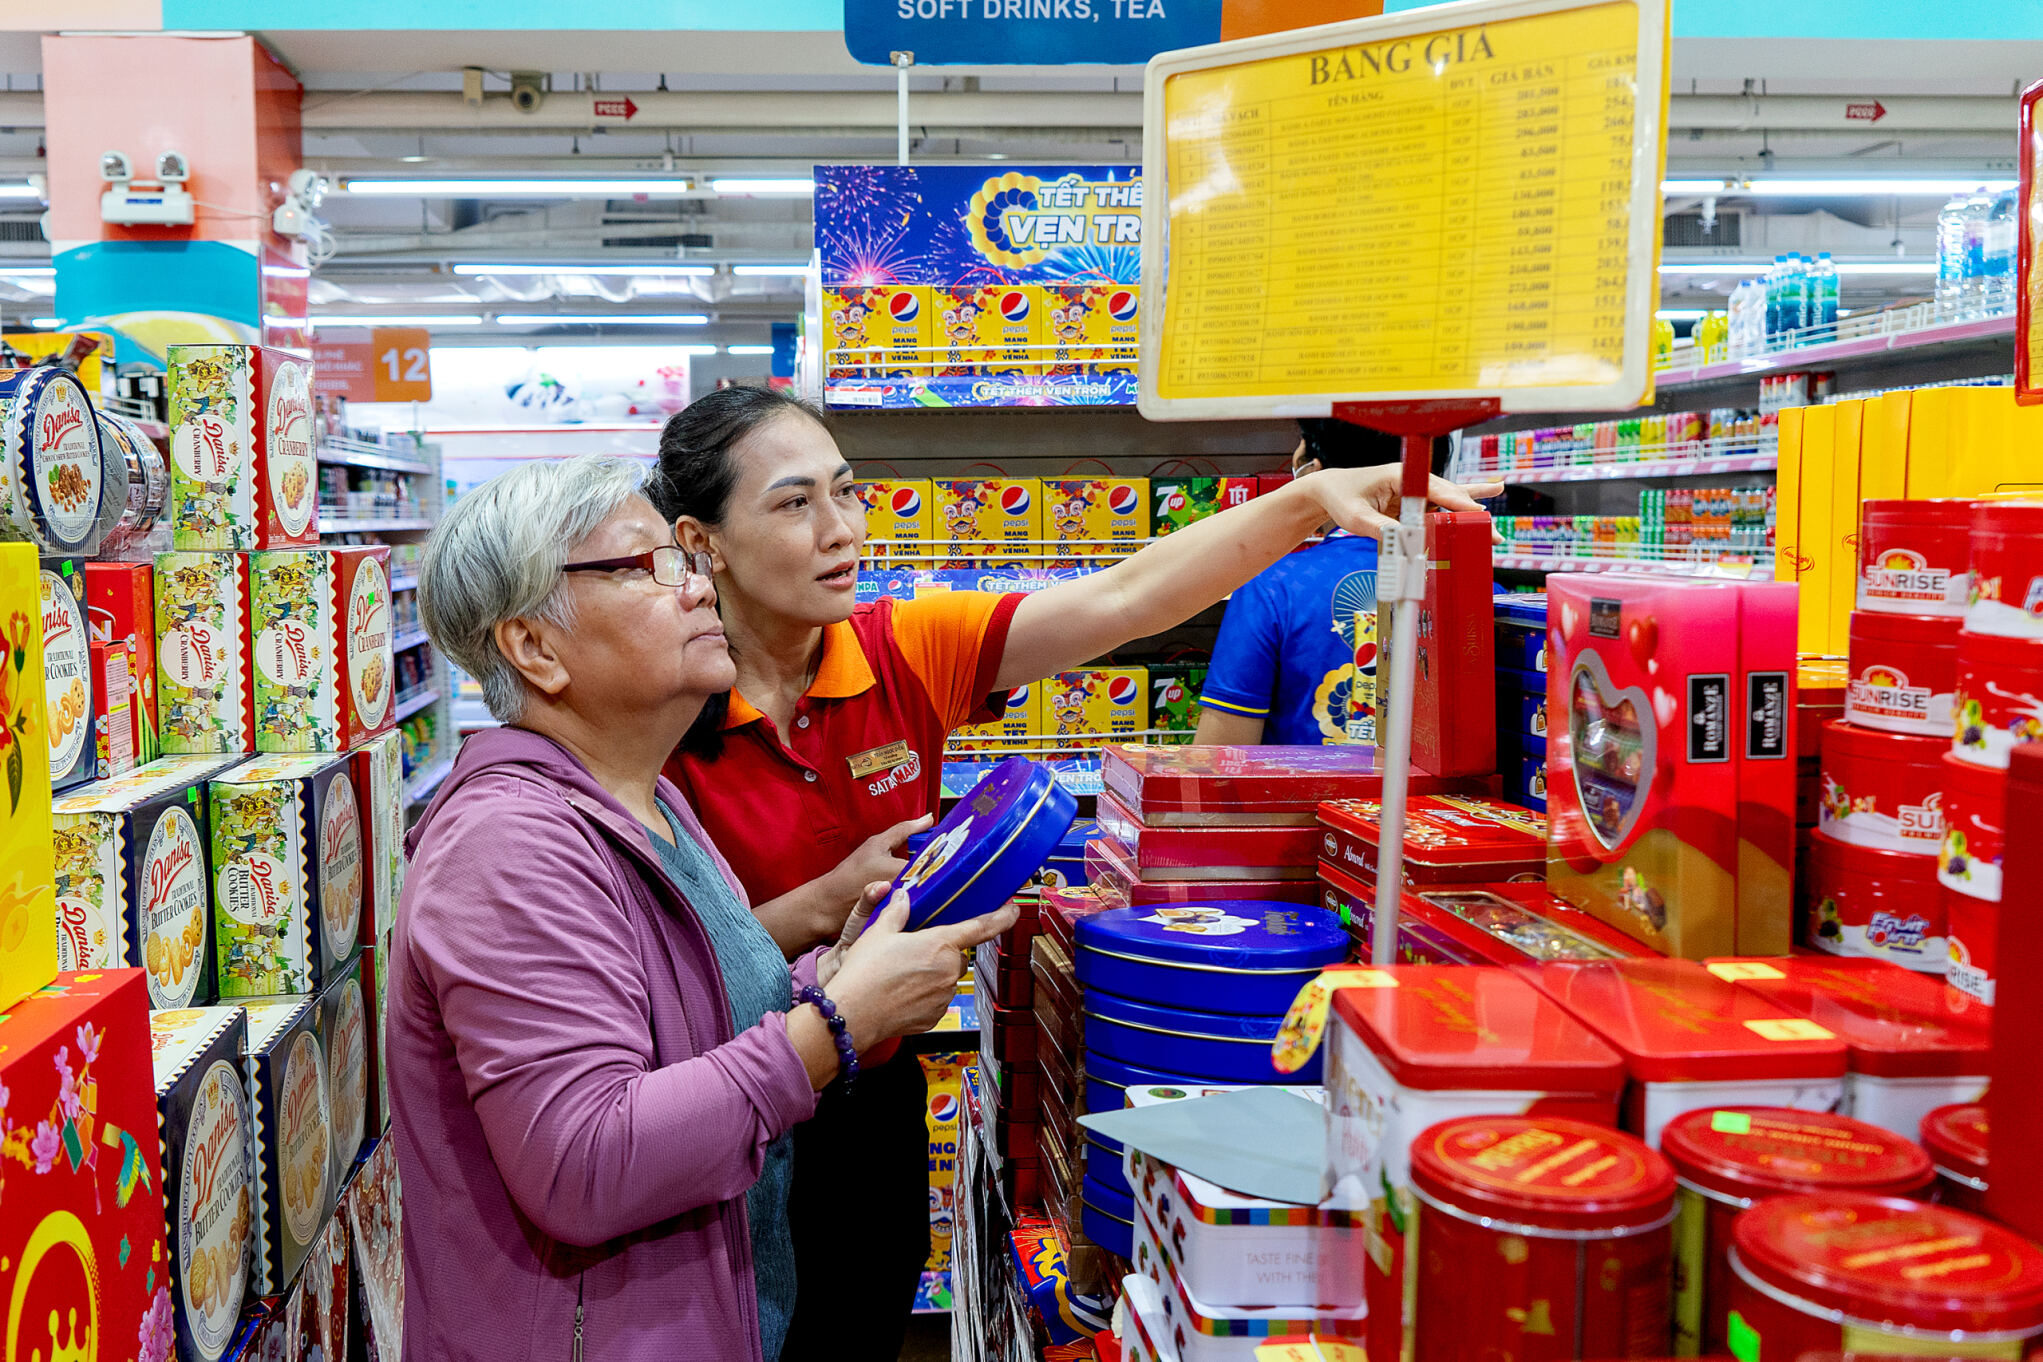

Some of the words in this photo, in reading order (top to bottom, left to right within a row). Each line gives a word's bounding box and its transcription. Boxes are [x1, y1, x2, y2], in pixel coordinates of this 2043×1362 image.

[898, 0, 972, 19] SOFT
[983, 0, 1100, 22] DRINKS,
[1111, 0, 1166, 19] TEA
[1038, 174, 1090, 208] TẾT
[1092, 178, 1143, 208] THÊ
[1008, 215, 1087, 250] VẸN
[892, 325, 919, 335] pepsi
[1002, 325, 1029, 334] pepsi
[1110, 325, 1137, 333] pepsi
[381, 347, 428, 382] 12
[42, 402, 83, 452] Danisa
[275, 396, 307, 436] Danisa
[193, 427, 202, 476] CRANBERRY
[202, 418, 230, 477] Danisa
[278, 437, 309, 457] CRANBERRY
[1228, 484, 1249, 505] TẾT
[894, 520, 920, 530] pepsi
[1003, 519, 1029, 528] pepsi
[1111, 519, 1137, 528] pepsi
[1866, 572, 1947, 591] SUNRISE
[180, 634, 189, 681] CRANBERRY
[189, 623, 217, 682] Danisa
[274, 632, 284, 680] CRANBERRY
[284, 623, 311, 681] Danisa
[357, 631, 386, 653] CRANBERRY
[50, 662, 79, 680] COOKIES
[1851, 686, 1928, 710] SUNRISE
[325, 800, 354, 864] Danisa
[149, 835, 193, 912] Danisa
[171, 879, 194, 899] TRADITIONAL
[228, 867, 239, 912] COOKIES
[239, 869, 250, 910] BUTTER
[249, 857, 279, 918] Danisa
[151, 907, 173, 930] BUTTER
[173, 892, 197, 920] COOKIES
[1347, 903, 1367, 928] lmond
[61, 901, 95, 970] Danisa
[286, 1060, 318, 1146] Danisa
[192, 1099, 238, 1223] Danisa
[217, 1154, 241, 1191] TRADITIONAL
[194, 1200, 221, 1246] BUTTER
[219, 1172, 244, 1212] COOKIES
[1246, 1252, 1281, 1265] TASTE
[1285, 1252, 1314, 1265] FINE
[1256, 1272, 1291, 1283] WITH
